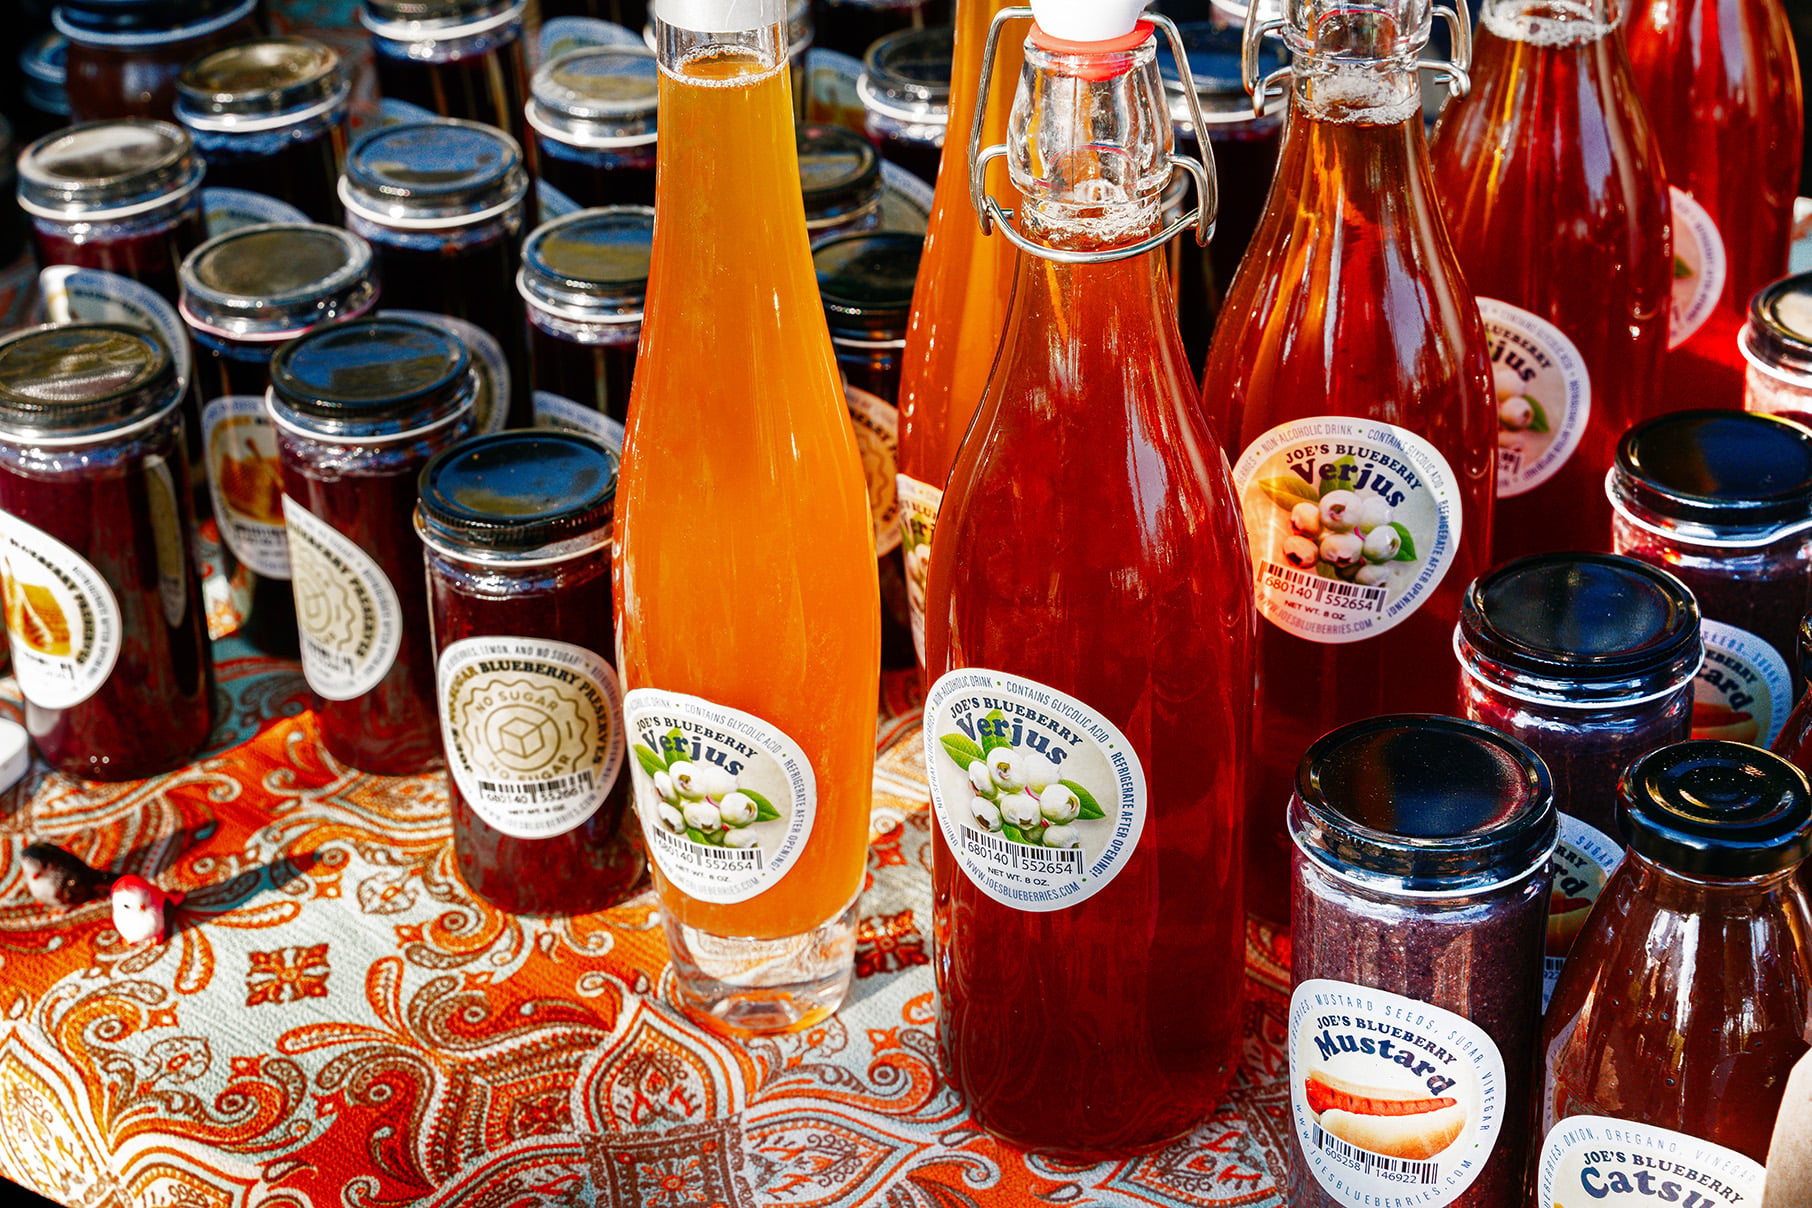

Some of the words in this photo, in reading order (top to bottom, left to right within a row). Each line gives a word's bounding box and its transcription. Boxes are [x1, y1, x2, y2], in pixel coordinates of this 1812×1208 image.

[1286, 444, 1329, 464] JOE'S
[1335, 443, 1422, 490] BLUEBERRY
[1290, 457, 1405, 507] Verjus
[1261, 424, 1322, 452] NON-ALCOHOLIC
[1325, 424, 1353, 435] DRINK
[1367, 428, 1407, 453] CONTAINS
[1437, 500, 1450, 555] REFRIGERATE
[1264, 576, 1313, 600] 680140
[1325, 594, 1372, 611] 552654
[1284, 600, 1302, 611] NET
[970, 675, 993, 689] DRINK
[1006, 681, 1051, 706] CONTAINS
[1696, 663, 1754, 710] tard
[476, 696, 493, 713] NO
[498, 690, 559, 710] SUGAR
[479, 660, 581, 685] BLUEBERRY
[579, 681, 608, 764] PRESERVES
[685, 703, 726, 726] CONTAINS
[1051, 698, 1092, 728] GLYCOLIC
[636, 716, 661, 732] JOE'S
[663, 716, 758, 760] BLUEBERRY
[727, 717, 766, 742] GLYCOLIC
[950, 697, 980, 719] JOE'S
[982, 697, 1083, 746] BLUEBERRY
[956, 712, 1067, 765] Verjus
[1088, 724, 1110, 744] ACID
[642, 729, 744, 776] Verjus
[763, 738, 783, 754] ACID
[784, 758, 806, 807] REFRIGERATE
[1110, 751, 1135, 811] REFRIGERATE
[794, 808, 806, 833] AFTER
[1116, 811, 1133, 838] AFTER
[705, 859, 752, 871] 552654
[968, 842, 1008, 865] 680140
[1022, 860, 1072, 875] 552654
[988, 866, 1005, 878] NET
[1006, 873, 1022, 882] WT.
[1034, 878, 1050, 887] OZ.
[1089, 838, 1123, 878] OPENING!
[966, 857, 1080, 901] WWW.JOESBLUEBERRIES.COM
[1317, 1015, 1350, 1030] JOE'S
[1355, 1017, 1457, 1065] BLUEBERRY
[1314, 993, 1373, 1010] MUSTARD
[1385, 1005, 1438, 1033] SEEDS,
[1448, 1030, 1484, 1069] SUGAR,
[1479, 1071, 1496, 1131] VINEGAR
[1314, 1030, 1456, 1096] Mustard
[1563, 1128, 1599, 1147] ONION,
[1605, 1129, 1682, 1155] OREGANO,
[1325, 1147, 1361, 1171] 605258
[1375, 1169, 1417, 1184] 146922
[1584, 1150, 1626, 1165] JOE'S
[1632, 1154, 1744, 1204] BLUEBERRY
